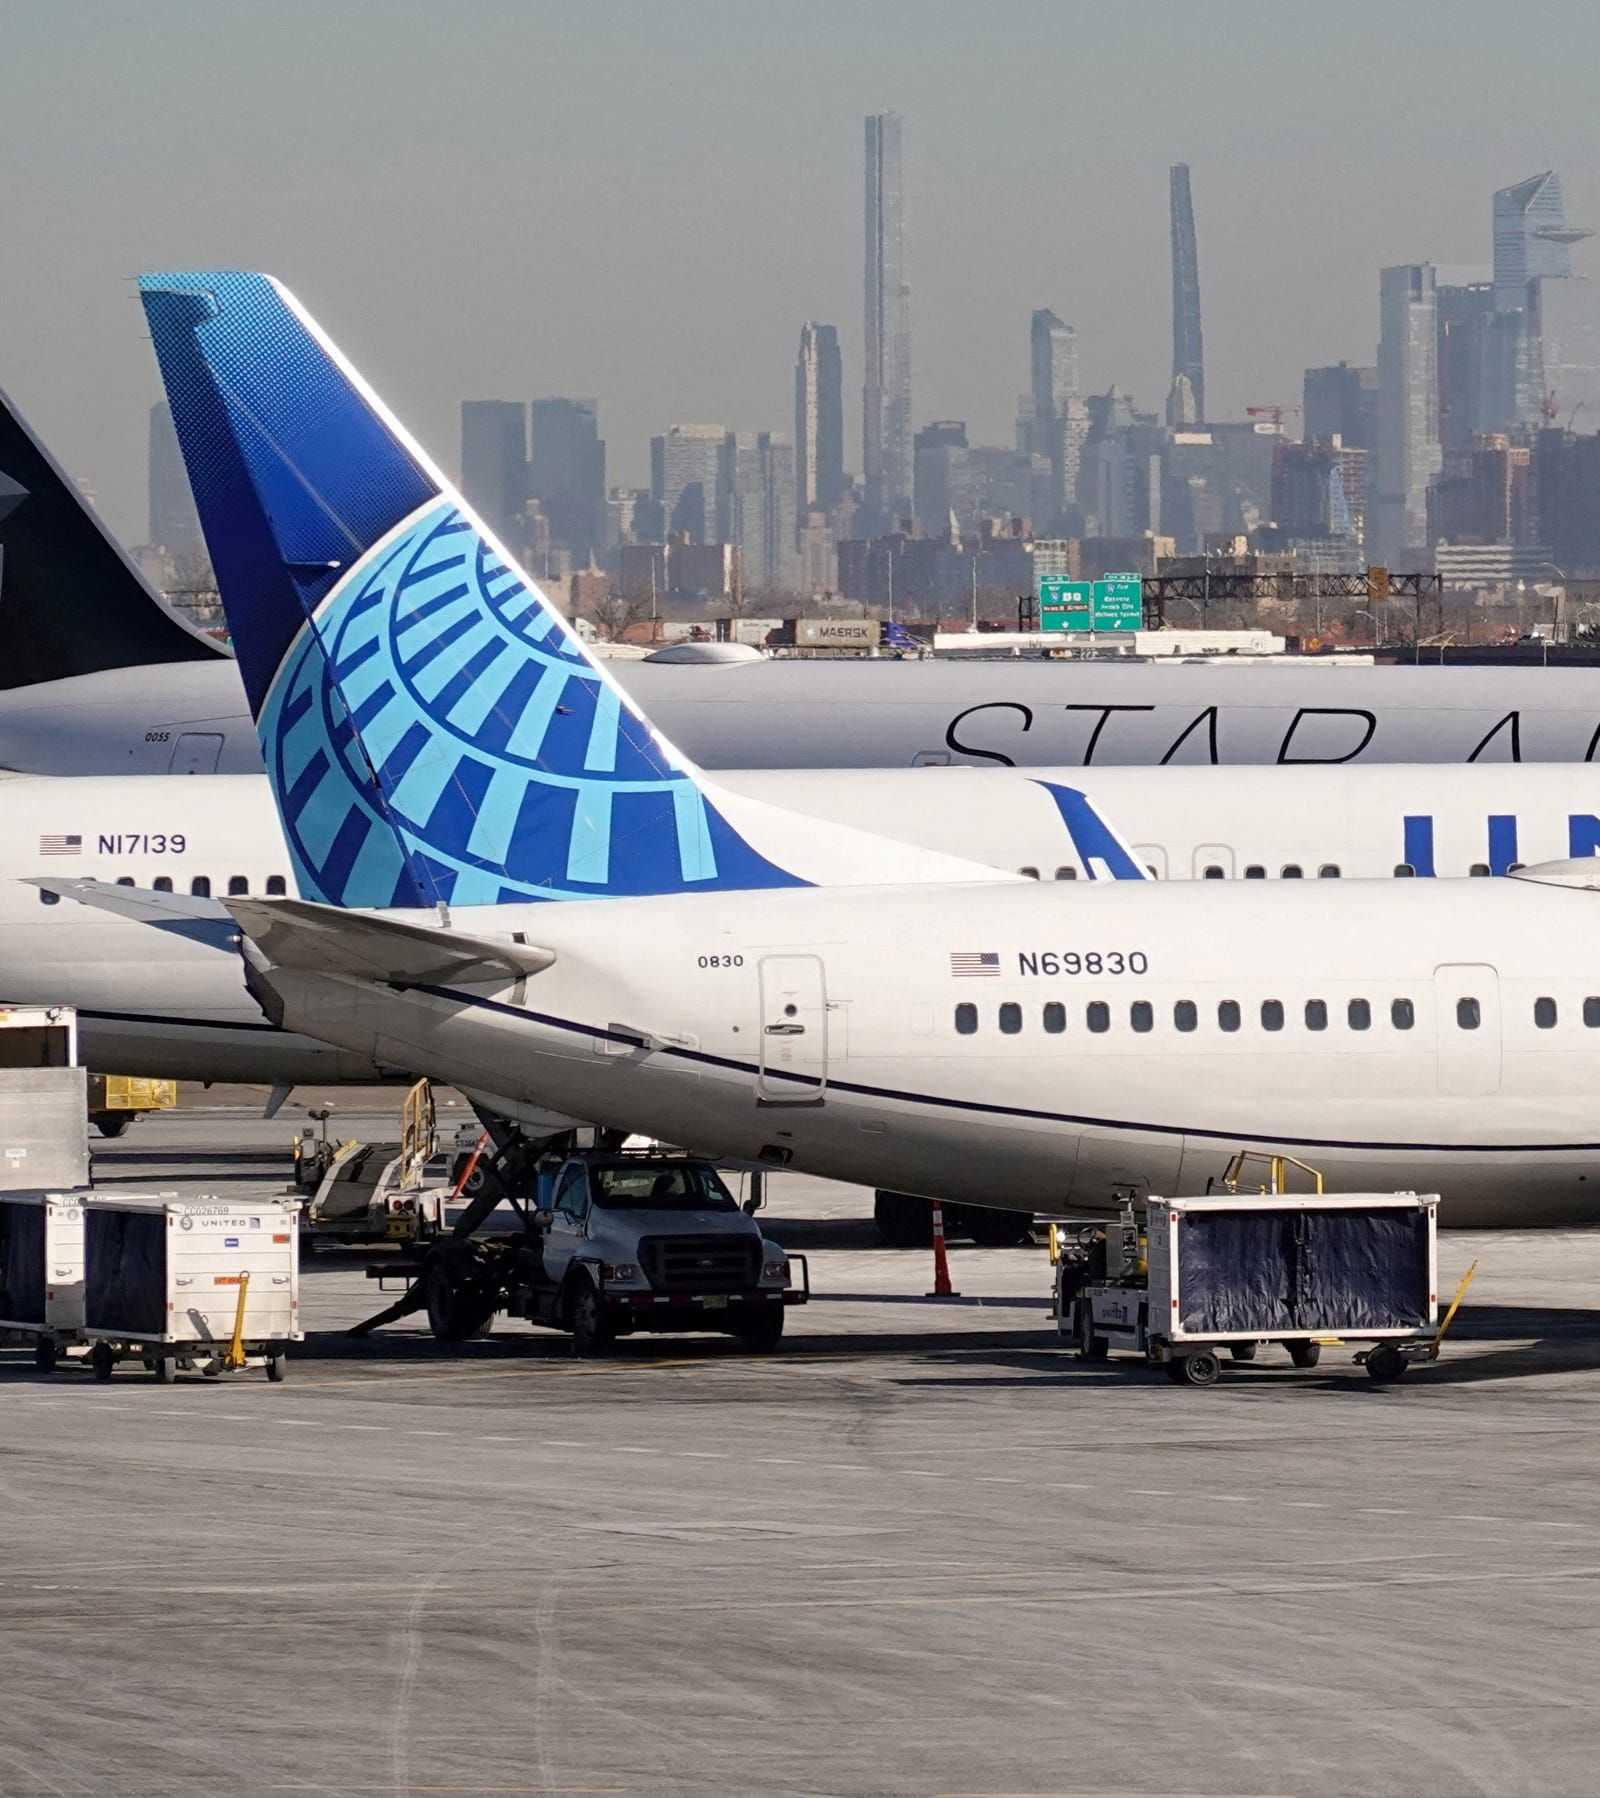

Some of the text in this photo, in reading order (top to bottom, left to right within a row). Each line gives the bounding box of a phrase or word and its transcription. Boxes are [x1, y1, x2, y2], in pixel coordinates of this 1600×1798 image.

[819, 627, 868, 638] MAERSK
[145, 732, 170, 742] 0055
[99, 834, 186, 854] N17139
[698, 954, 744, 969] 0830
[1018, 951, 1148, 977] N69830
[201, 1219, 246, 1228] UNITED
